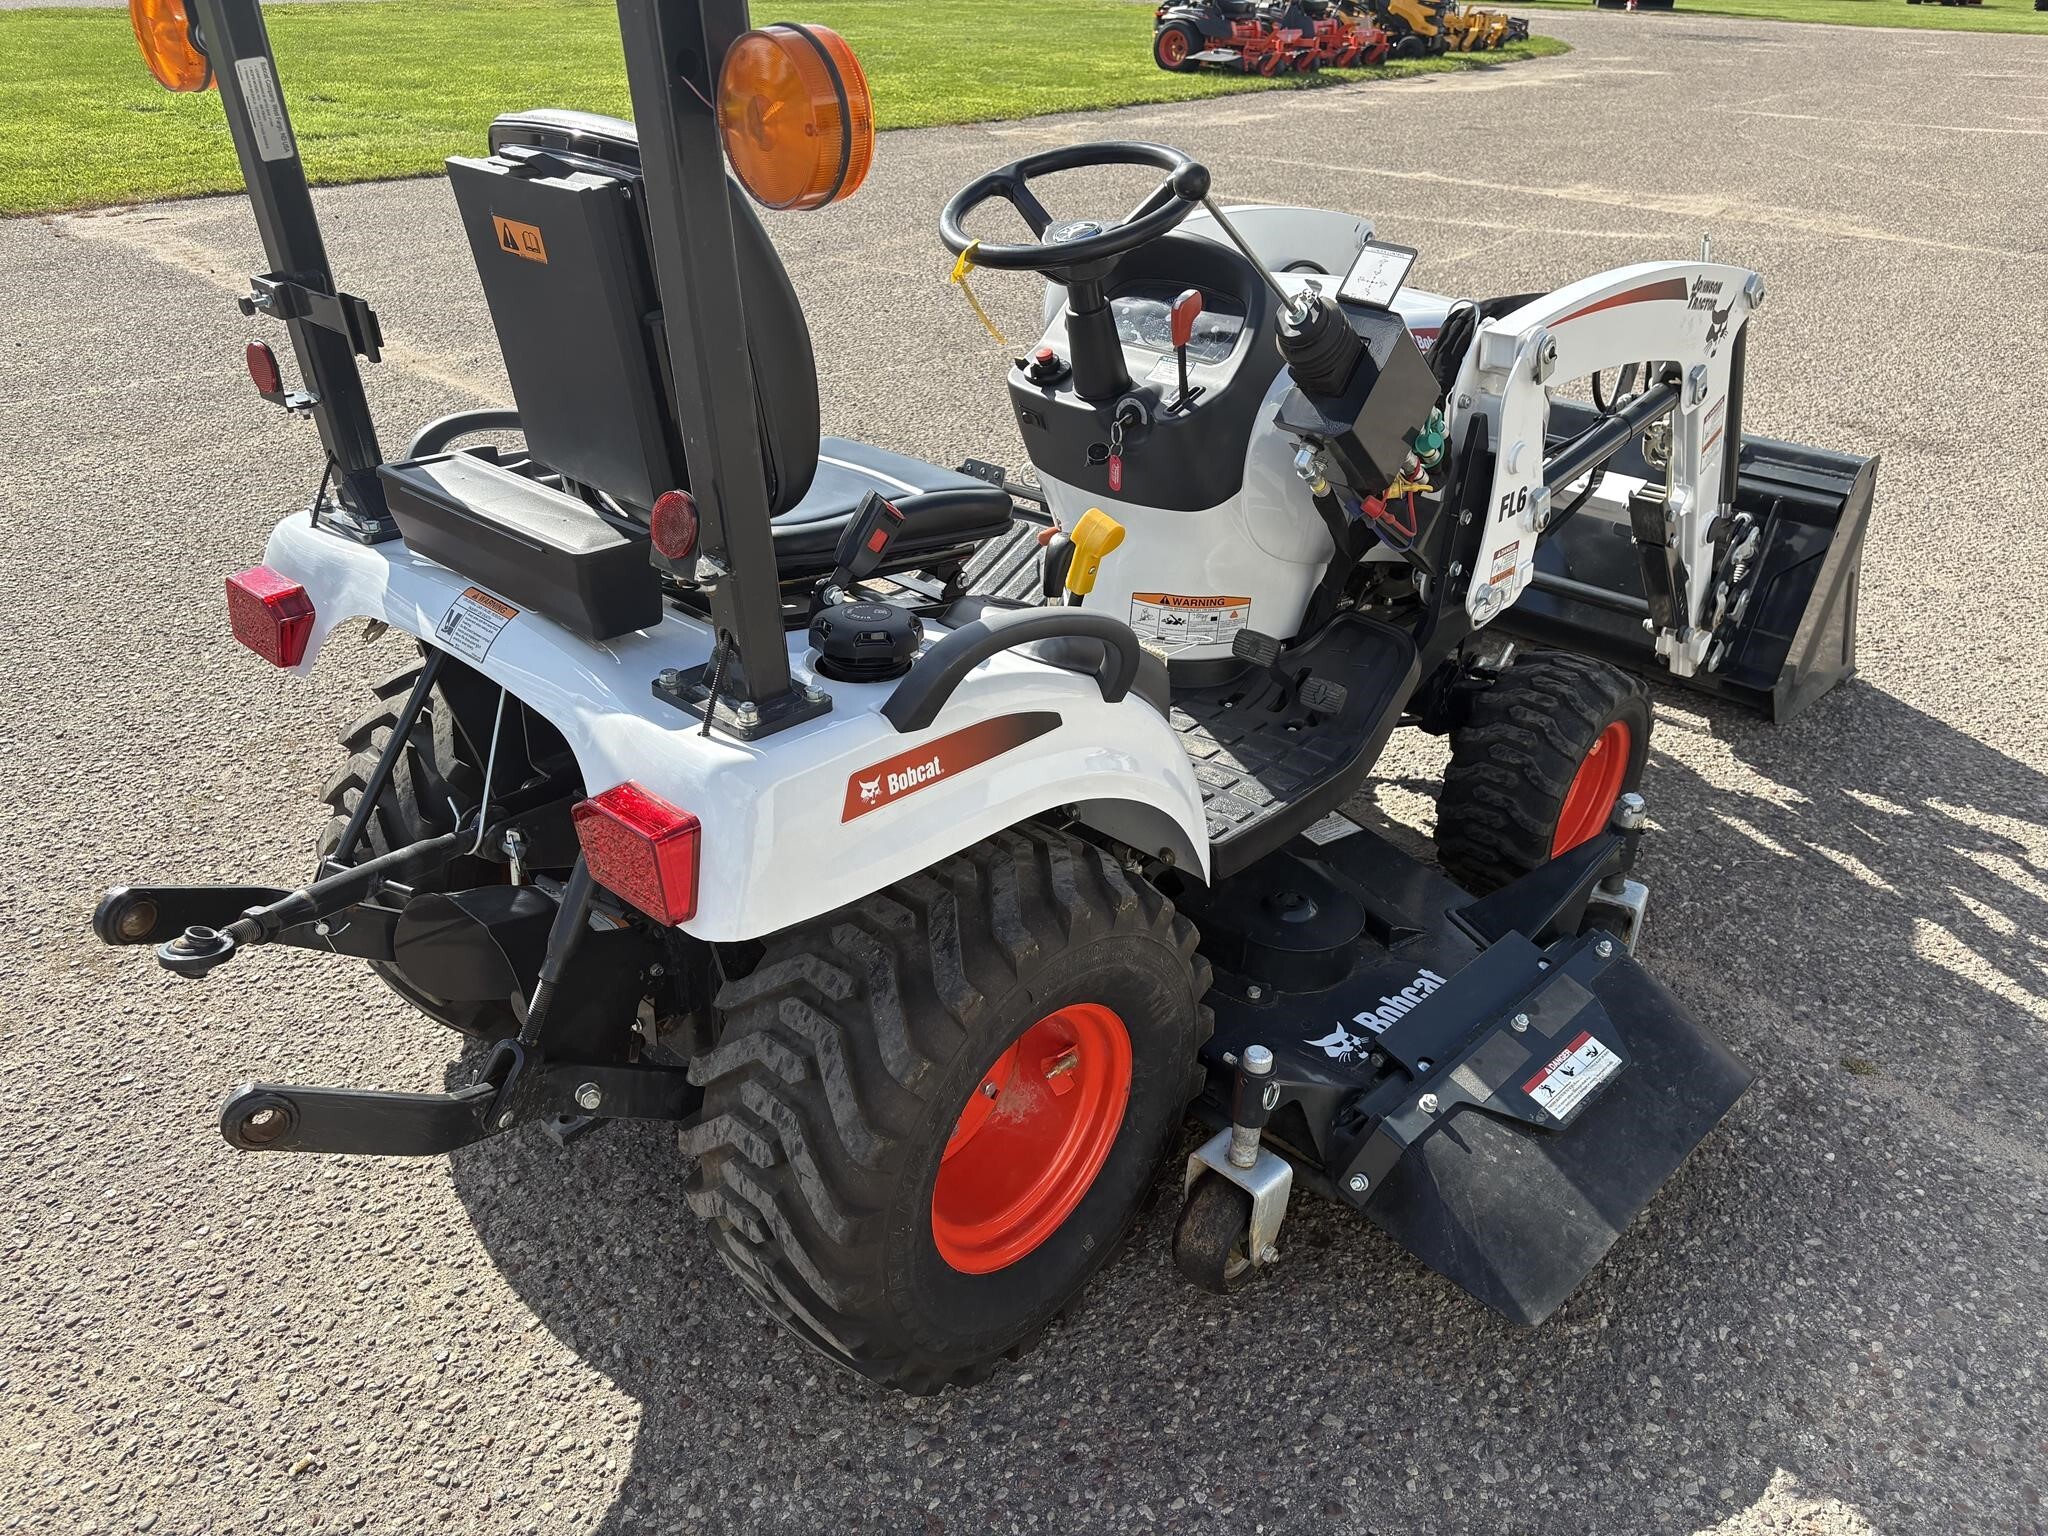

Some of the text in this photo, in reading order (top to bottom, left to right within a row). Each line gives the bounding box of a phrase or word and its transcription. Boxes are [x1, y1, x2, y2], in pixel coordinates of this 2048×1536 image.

[1498, 485, 1528, 523] FL6
[479, 594, 508, 614] WARNING
[1172, 597, 1225, 607] WARNING
[886, 755, 944, 796] Bobcat
[1550, 1048, 1573, 1071] DANGER
